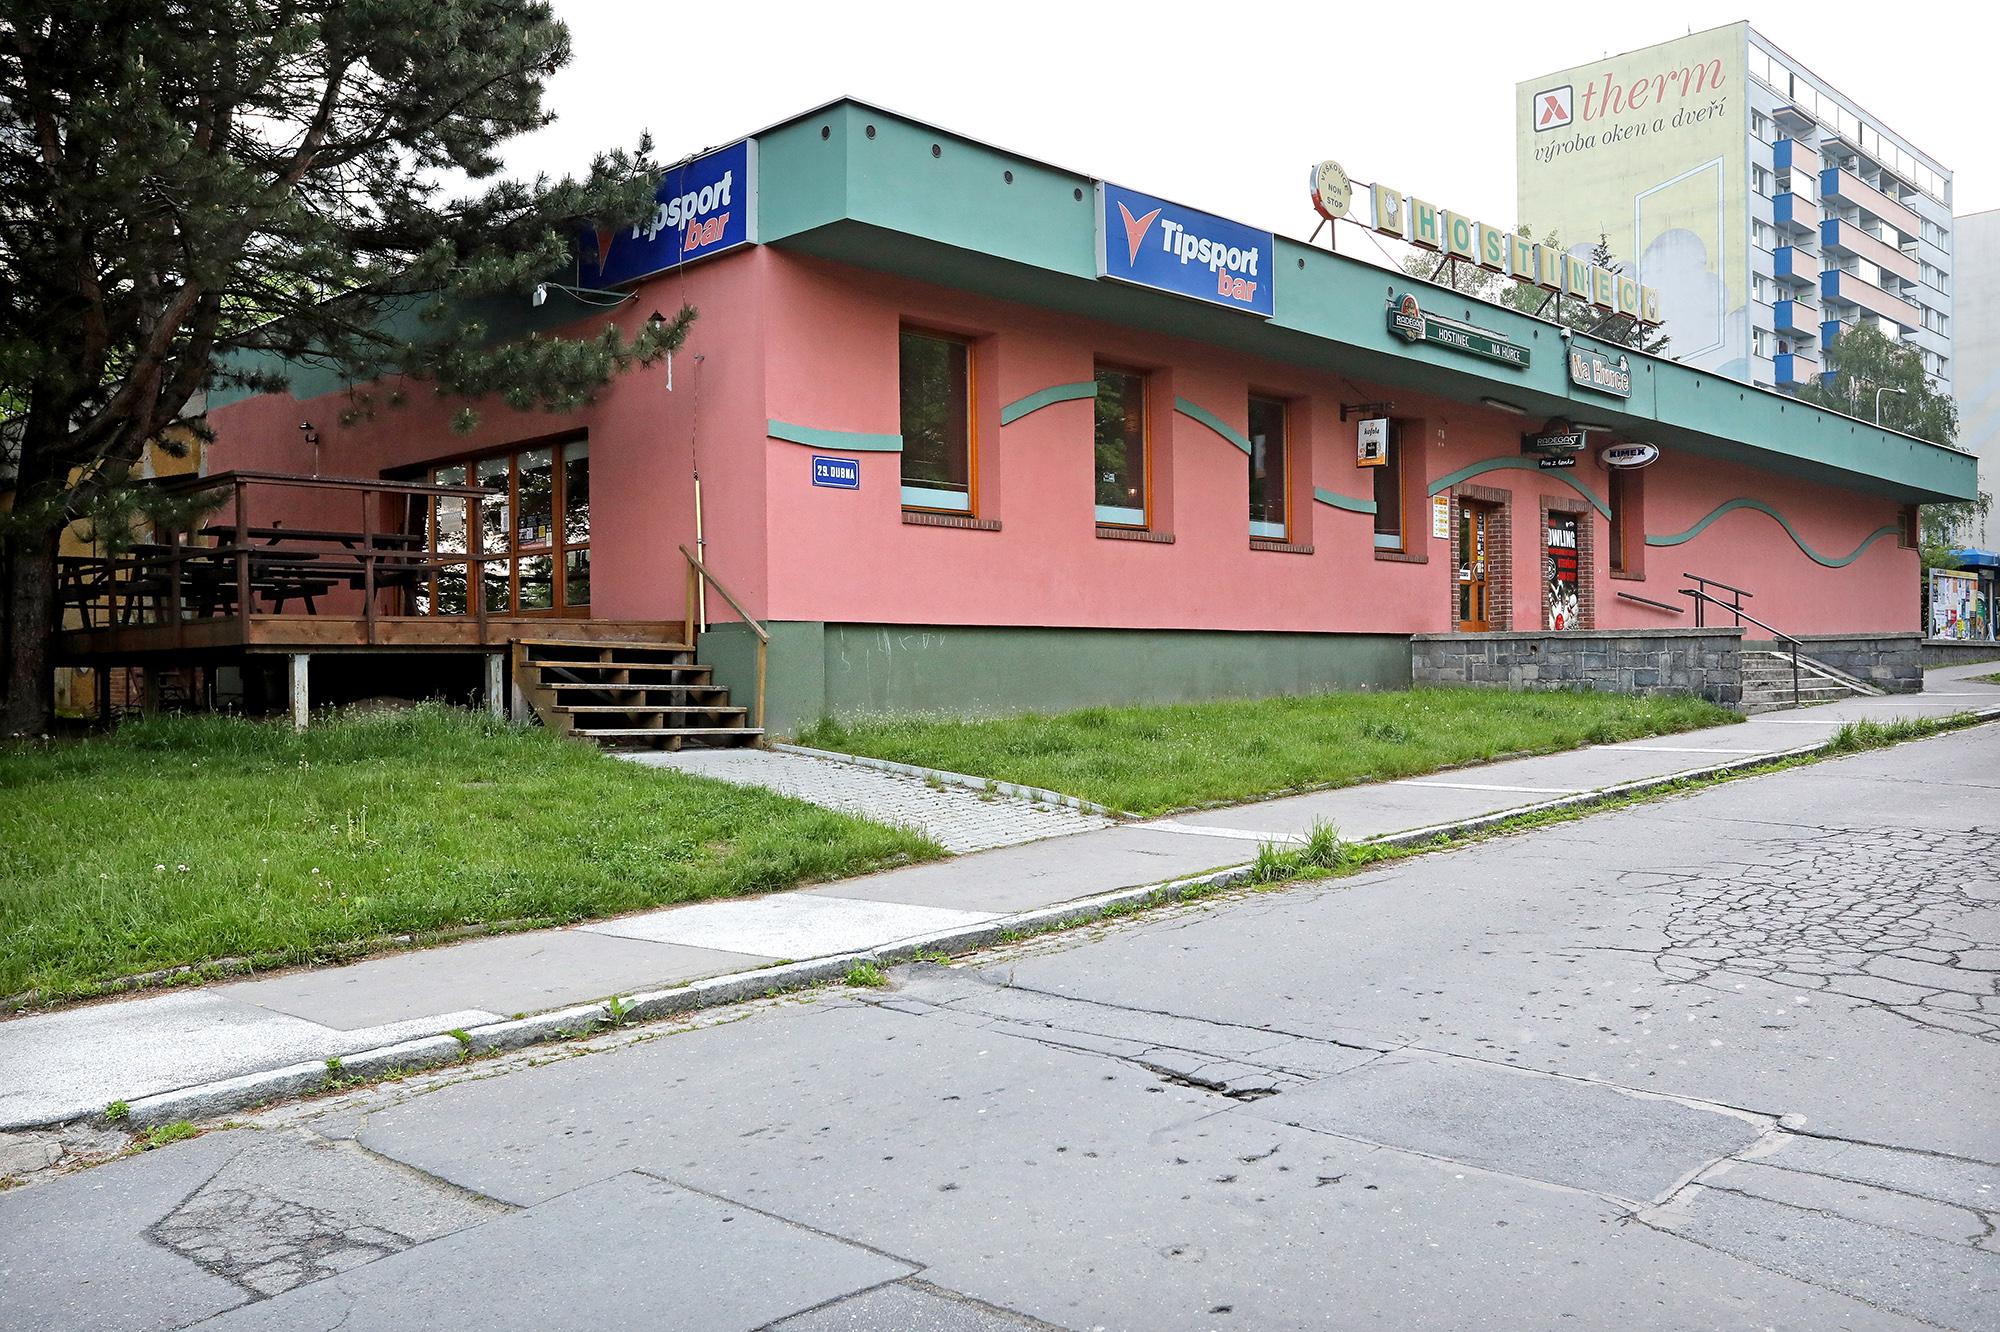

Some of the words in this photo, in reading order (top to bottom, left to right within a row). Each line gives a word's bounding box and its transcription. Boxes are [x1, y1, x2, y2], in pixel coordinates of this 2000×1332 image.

[1581, 58, 1726, 122] therm
[1534, 133, 1597, 163] výroba
[1602, 122, 1648, 145] oken
[1652, 117, 1665, 133] a
[1672, 97, 1727, 128] dveří
[632, 170, 732, 241] psport
[1327, 196, 1344, 208] STOP
[684, 211, 730, 252] bar
[1161, 219, 1258, 276] Tipsport
[1420, 205, 1635, 310] HOSTINEC
[1218, 267, 1257, 303] bar
[1438, 328, 1469, 348] HOSTINEC
[1491, 343, 1501, 356] NA
[1572, 353, 1591, 381] Na
[1536, 435, 1579, 447] RADEGAST
[1609, 446, 1647, 458] KIMEX
[817, 464, 829, 477] 29.
[830, 466, 855, 480] DUBNA
